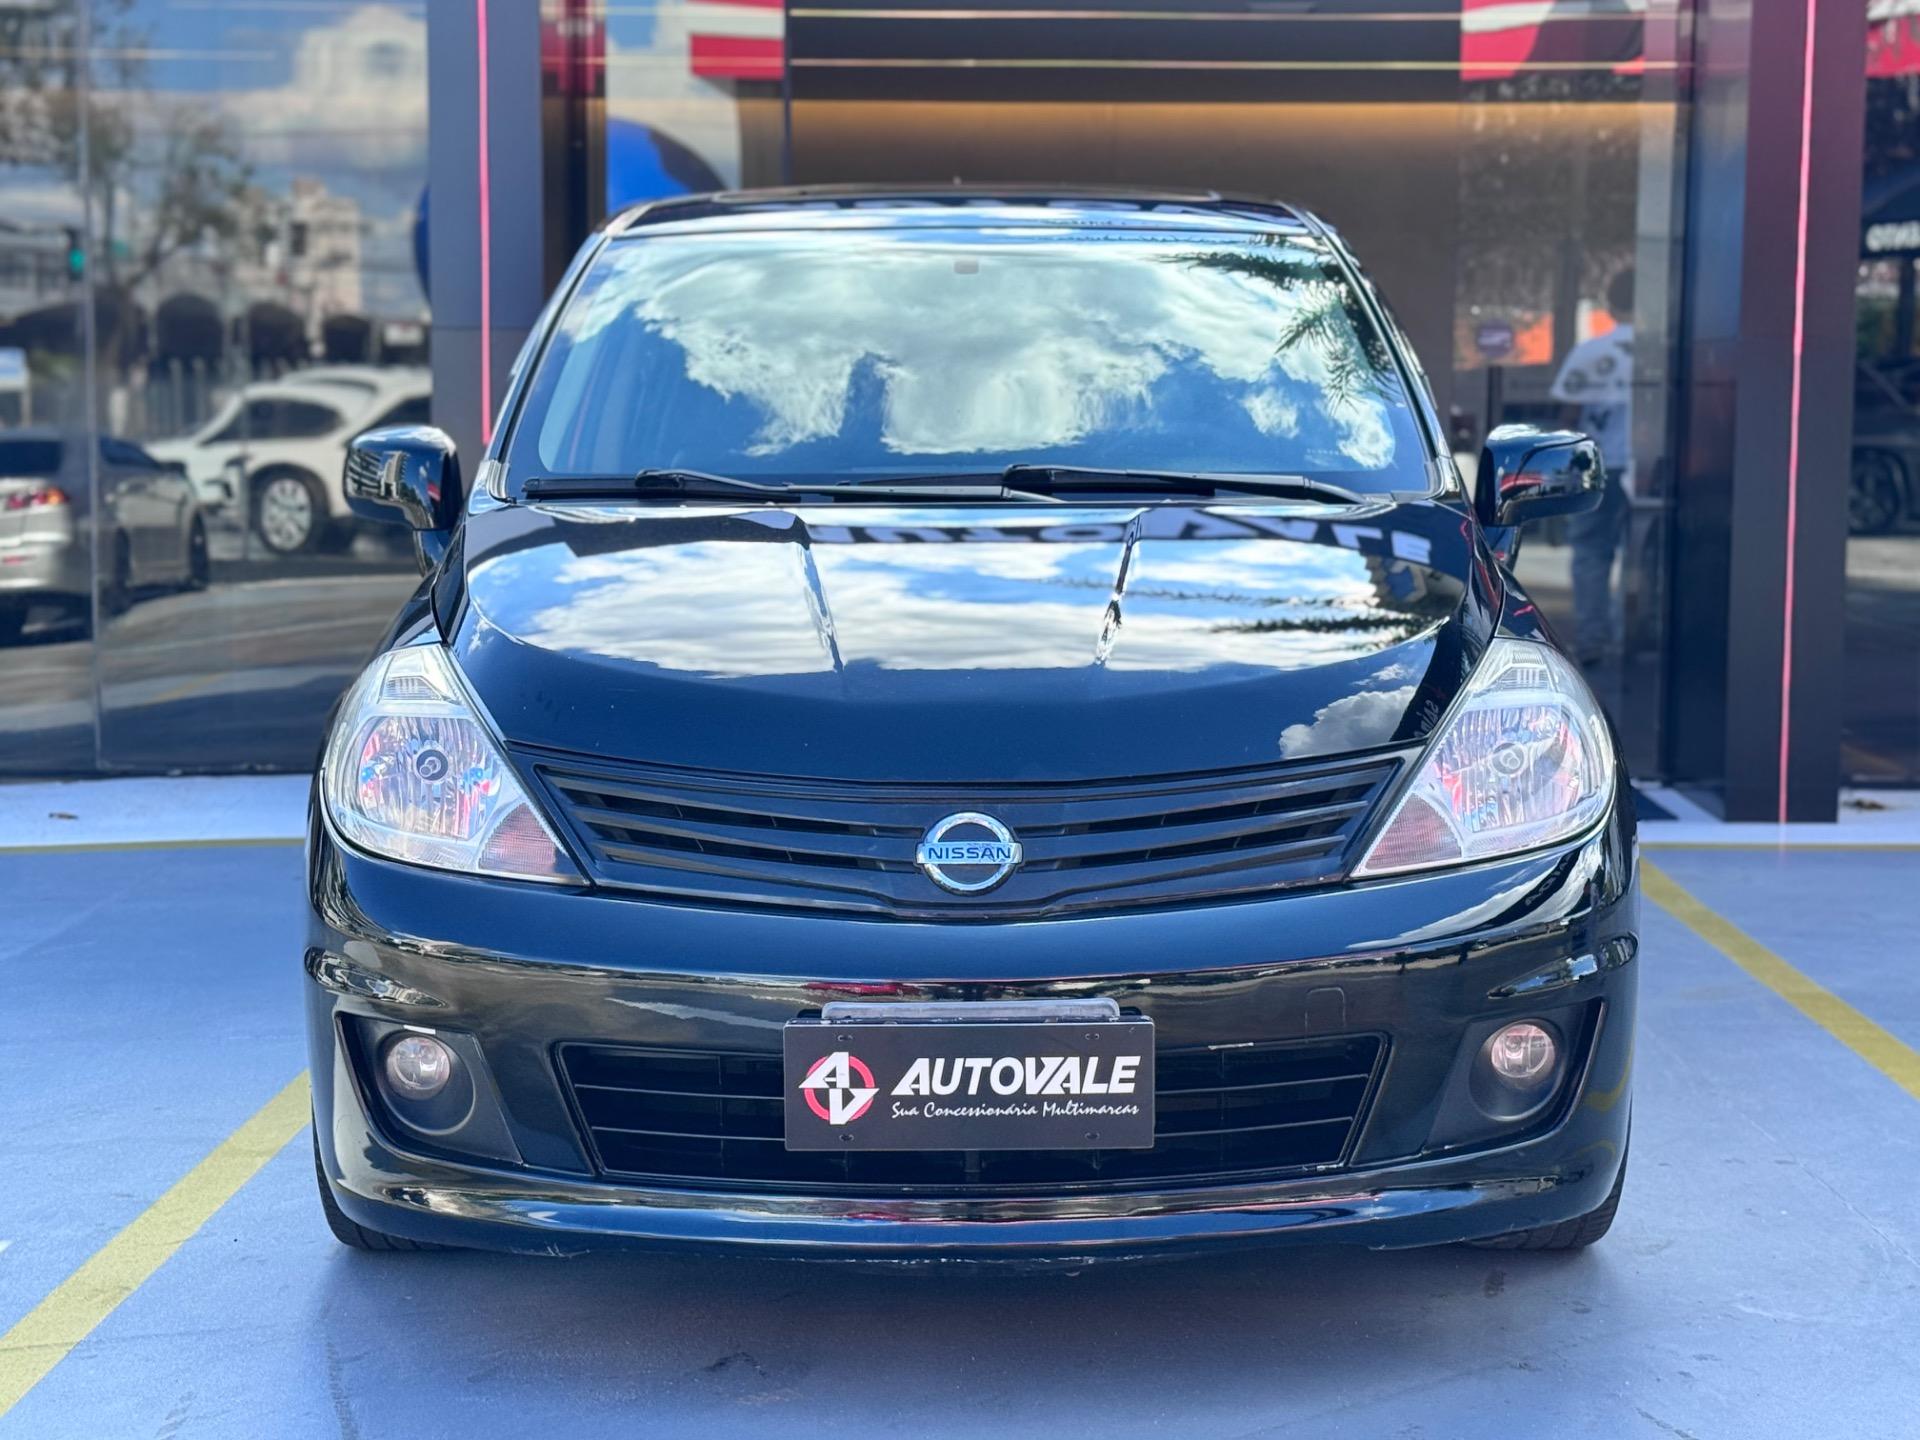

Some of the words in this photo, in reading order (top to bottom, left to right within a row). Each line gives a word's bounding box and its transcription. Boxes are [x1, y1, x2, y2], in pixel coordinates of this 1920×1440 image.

[928, 847, 1011, 860] NISSAN
[891, 1056, 1142, 1096] AUTOVALE
[891, 1101, 919, 1119] Sua
[923, 1102, 1038, 1118] Concessionária
[1042, 1100, 1140, 1117] Multimarcas
